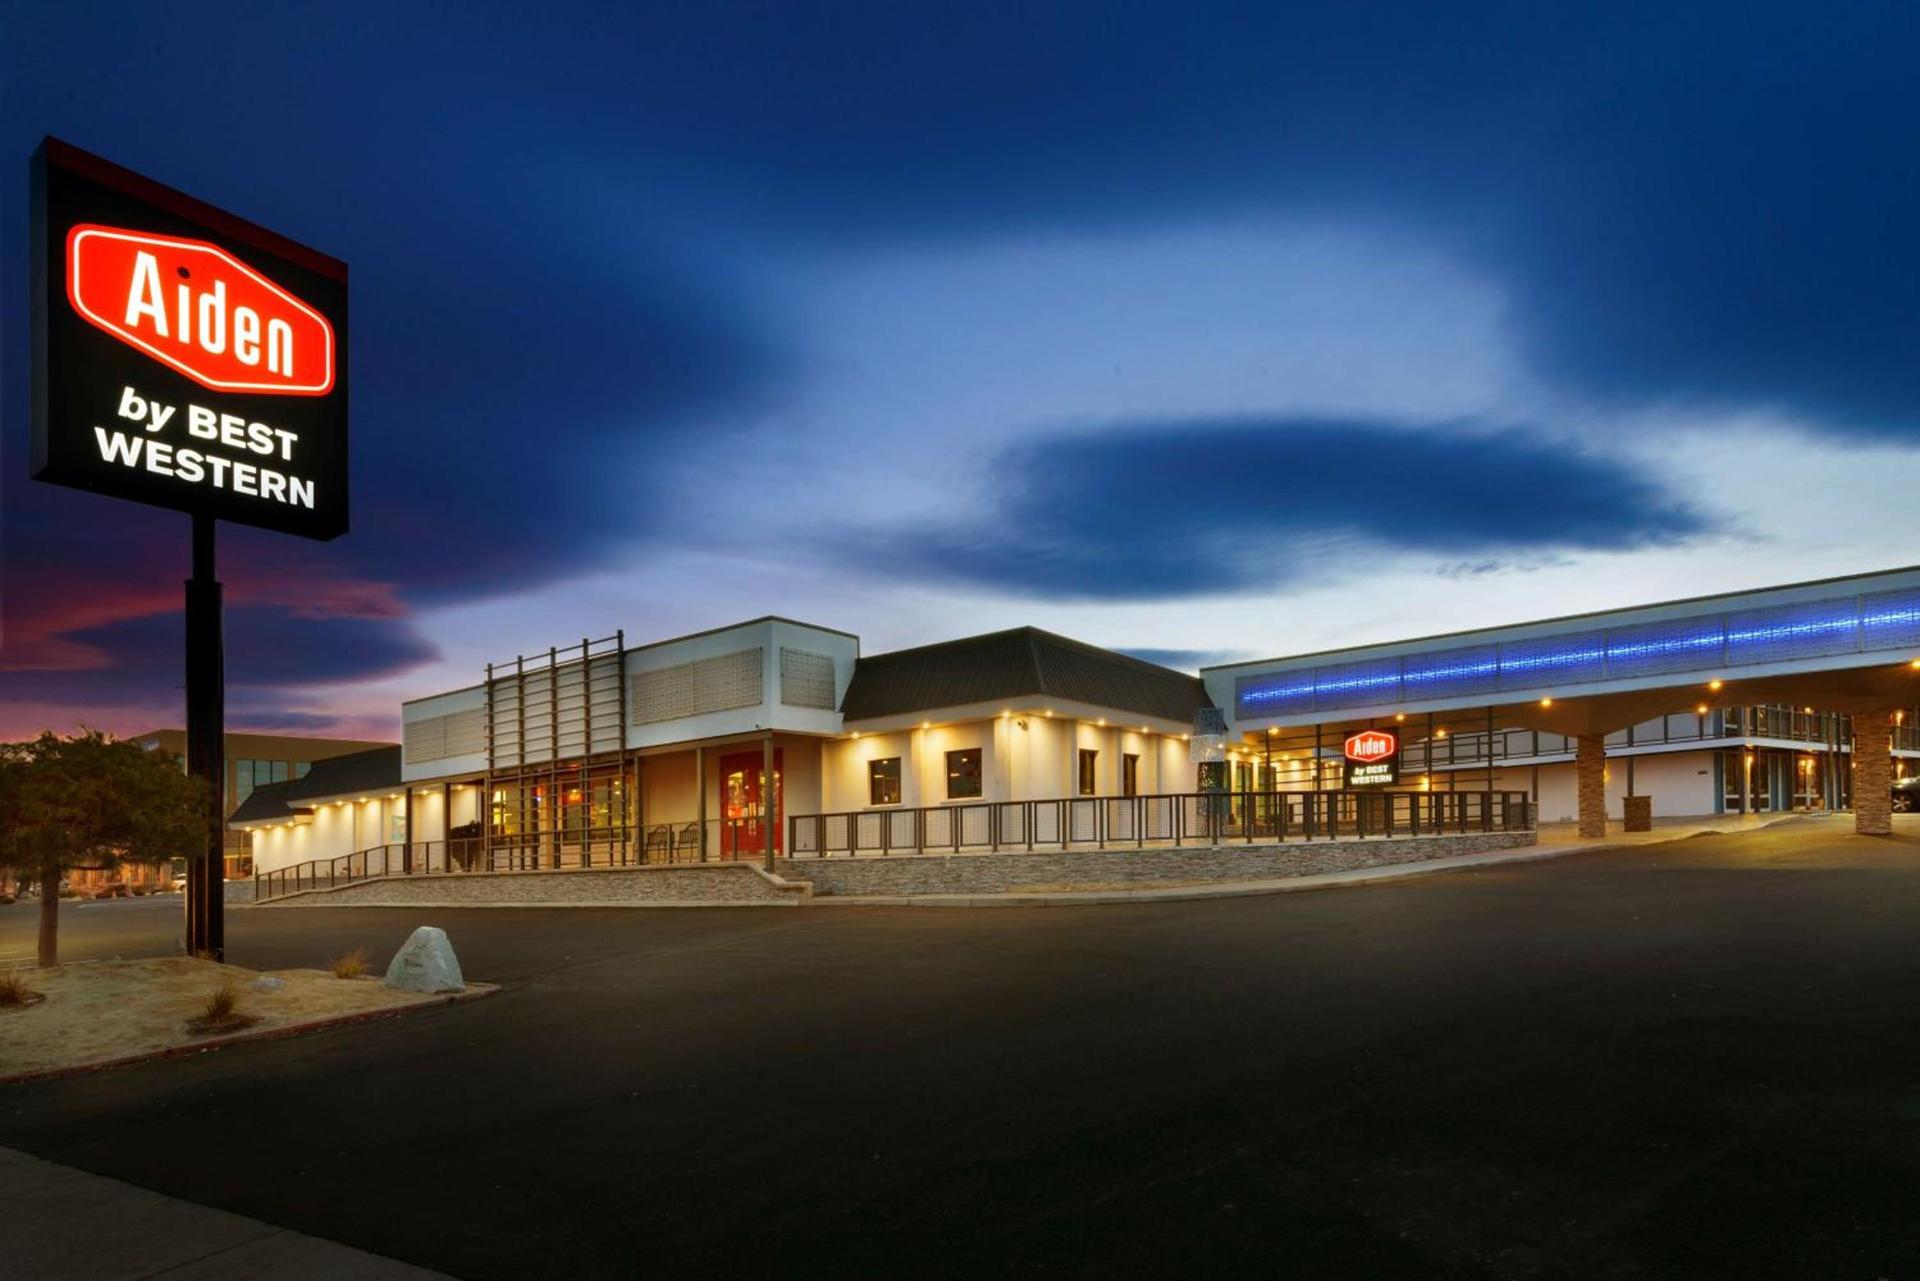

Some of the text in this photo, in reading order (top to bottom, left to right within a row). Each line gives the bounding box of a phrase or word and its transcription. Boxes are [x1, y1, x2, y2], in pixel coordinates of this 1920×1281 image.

[125, 250, 294, 378] Aiden
[118, 386, 298, 461] by BEST
[94, 426, 315, 510] WESTERN
[1354, 738, 1385, 756] Aiden
[1366, 765, 1388, 774] BEST
[1351, 774, 1392, 785] WESTERN
